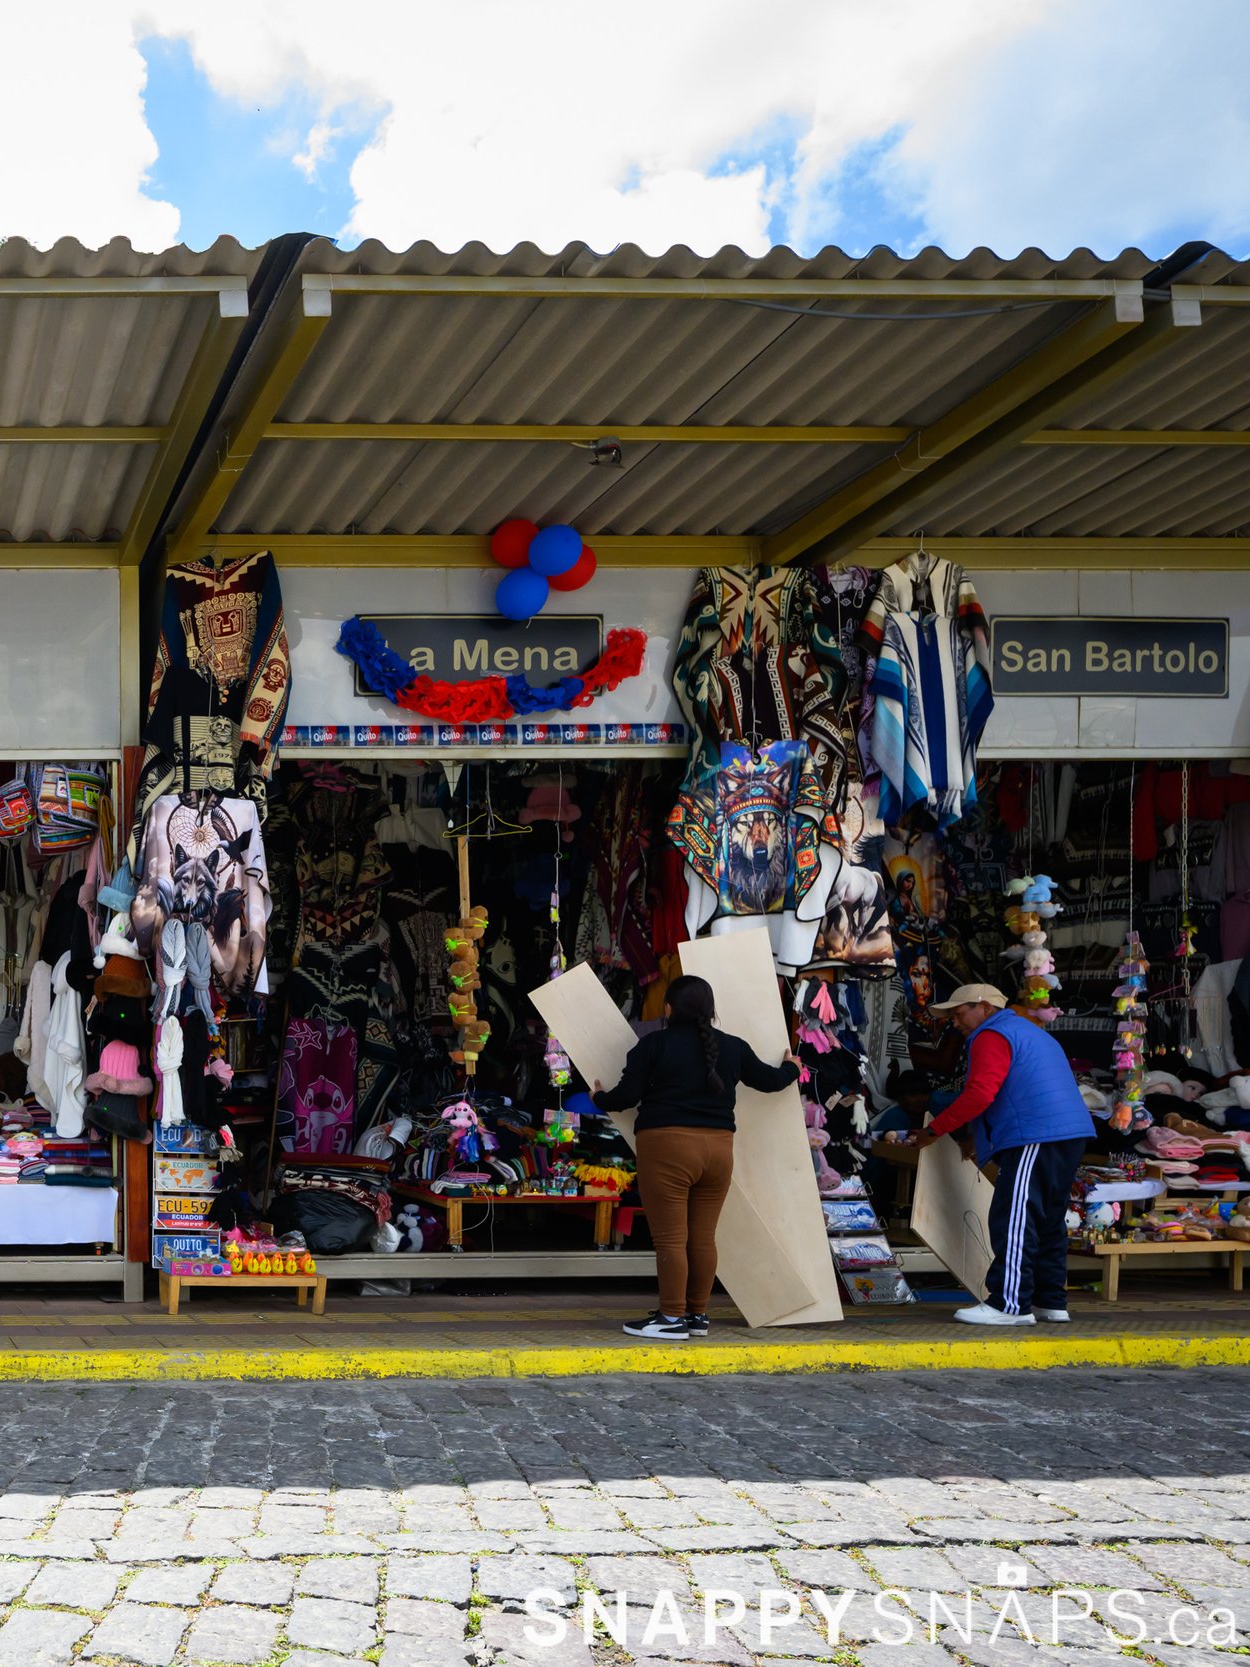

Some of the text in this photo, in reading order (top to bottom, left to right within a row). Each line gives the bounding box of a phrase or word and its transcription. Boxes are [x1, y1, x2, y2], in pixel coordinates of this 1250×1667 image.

[453, 639, 578, 671] Mena
[1000, 640, 1219, 674] San Bartolo
[313, 731, 332, 743] Quito
[357, 731, 376, 742] Quito
[397, 731, 417, 742] Quito
[441, 730, 460, 742] Quito
[481, 730, 501, 741] Quito
[525, 730, 544, 741] Quito
[565, 730, 584, 741] Quito
[608, 729, 627, 741] Quito
[648, 729, 666, 741] Quito
[173, 1239, 202, 1251] QUITO
